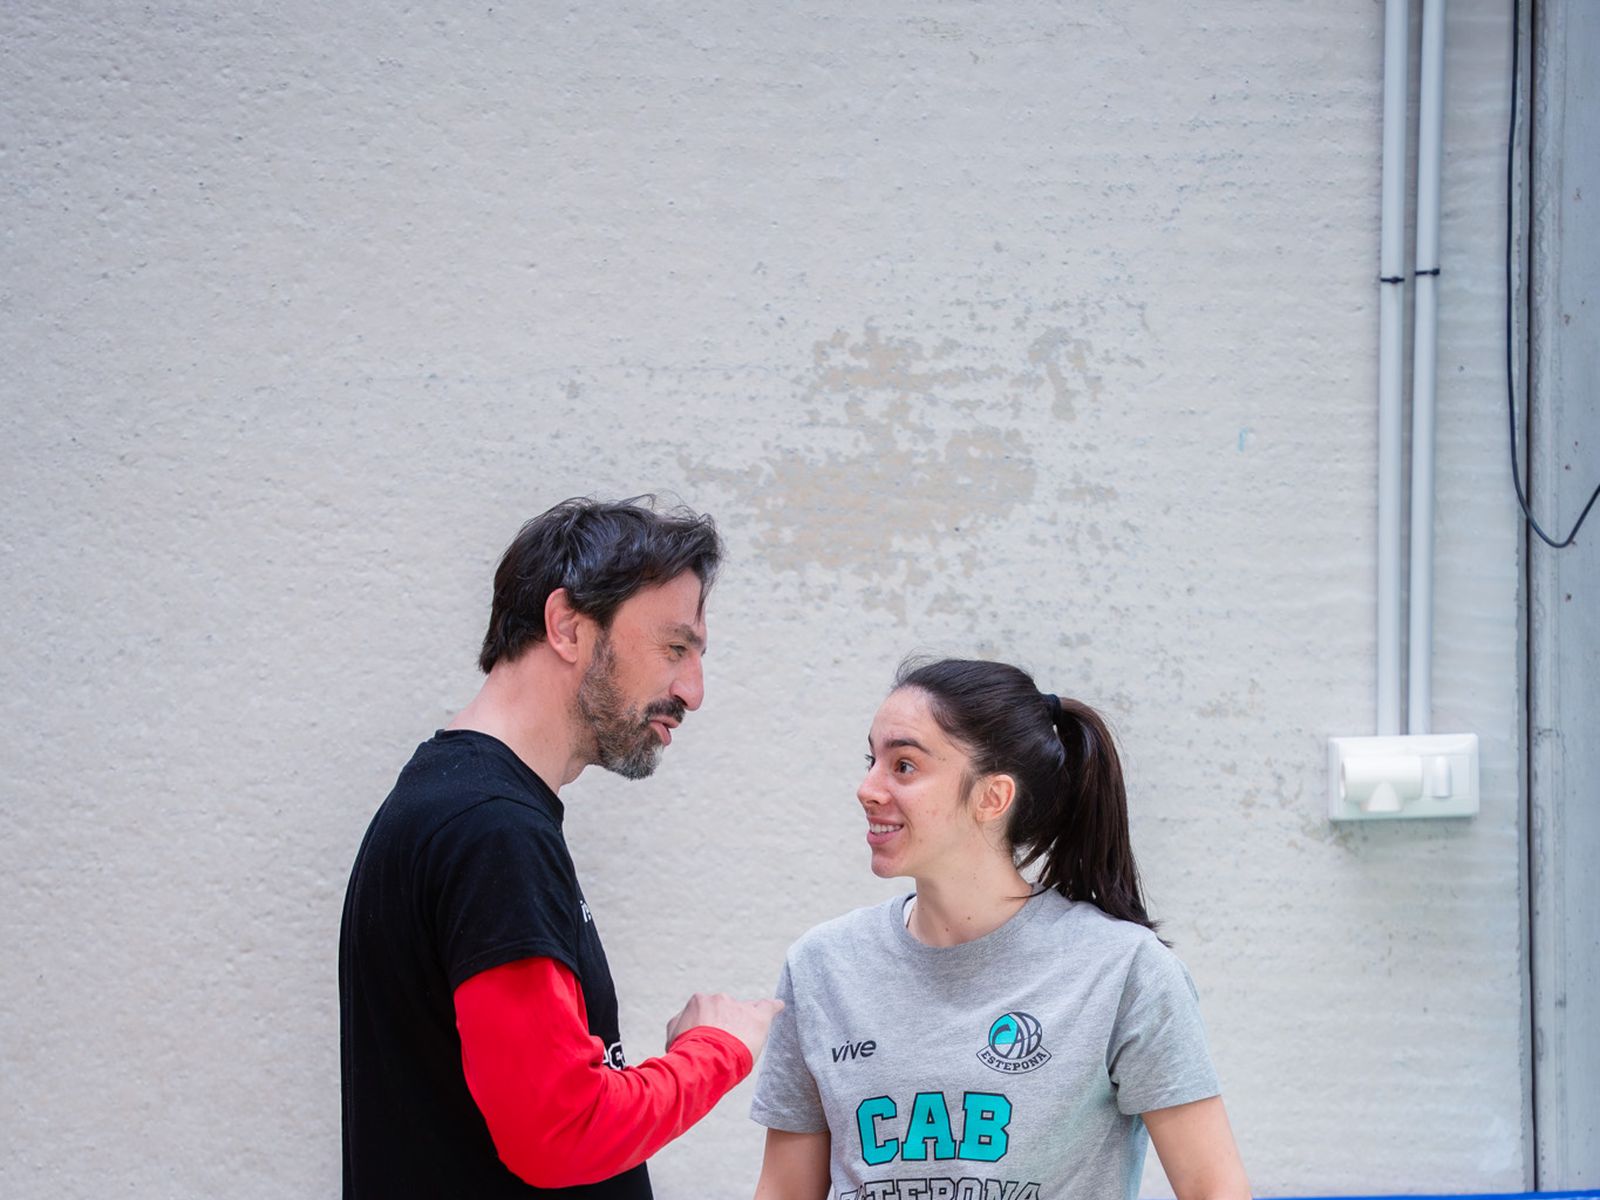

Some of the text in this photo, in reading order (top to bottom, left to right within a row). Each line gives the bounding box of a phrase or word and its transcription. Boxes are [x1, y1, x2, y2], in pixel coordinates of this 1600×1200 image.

[831, 1040, 877, 1063] vive
[981, 1050, 1047, 1071] ESTEPONA
[856, 1091, 1013, 1167] CAB
